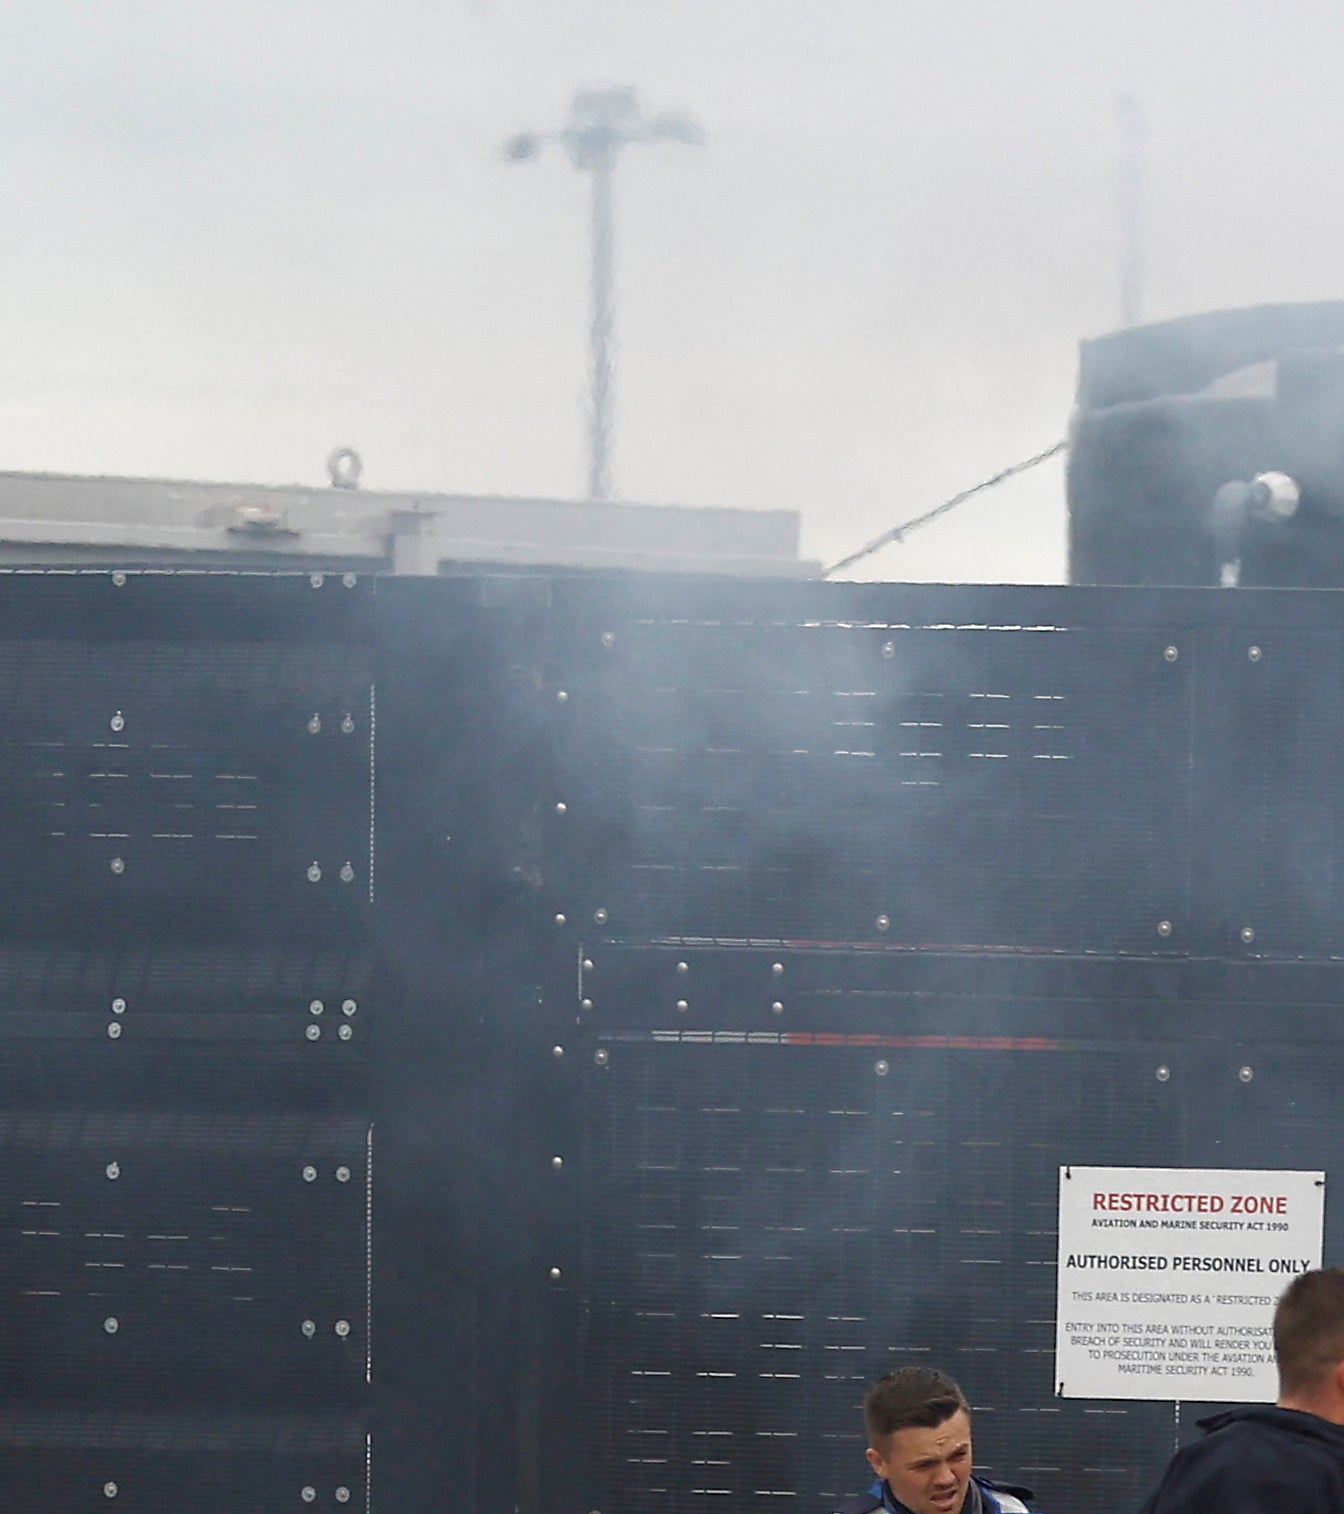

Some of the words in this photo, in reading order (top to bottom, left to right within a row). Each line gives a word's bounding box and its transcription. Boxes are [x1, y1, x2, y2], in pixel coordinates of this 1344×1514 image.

[1092, 1192, 1225, 1213] RESTRICTED
[1230, 1195, 1288, 1215] ZONE
[1091, 1218, 1137, 1229] AVIATION
[1138, 1219, 1159, 1230] AND
[1160, 1220, 1198, 1231] MARINE
[1198, 1220, 1245, 1232] SECURITY
[1246, 1221, 1265, 1232] ACT
[1266, 1222, 1289, 1233] 1990
[1066, 1254, 1168, 1271] AUTHORISED
[1172, 1256, 1265, 1273] PERSONNEL
[1268, 1258, 1310, 1275] ONLY
[1071, 1291, 1093, 1302] THIS
[1095, 1292, 1119, 1303] AREA
[1120, 1292, 1130, 1303] IS
[1132, 1293, 1188, 1304] DESIGNATED
[1189, 1294, 1202, 1304] AS
[1203, 1294, 1211, 1304] A
[1065, 1322, 1094, 1333] ENTRY
[1096, 1323, 1120, 1334] INTO
[1121, 1323, 1144, 1334] THIS
[1145, 1324, 1169, 1335] AREA
[1170, 1324, 1215, 1336] WITHOUT
[1216, 1326, 1274, 1337] AUTHORISAT
[1070, 1335, 1106, 1347] BREACH
[1107, 1336, 1121, 1347] OF
[1122, 1337, 1167, 1348] SECURITY
[1168, 1338, 1188, 1349] AND
[1189, 1338, 1213, 1349] WILL
[1214, 1339, 1250, 1350] RENDER
[1087, 1349, 1101, 1360] TO
[1102, 1350, 1167, 1362] PROSECUTION
[1168, 1351, 1200, 1362] UNDER
[1201, 1352, 1220, 1363] THE
[1221, 1353, 1265, 1364] AVIATION
[1117, 1363, 1163, 1375] MARITIME
[1165, 1364, 1209, 1376] SECURITY
[1210, 1366, 1229, 1376] ACT
